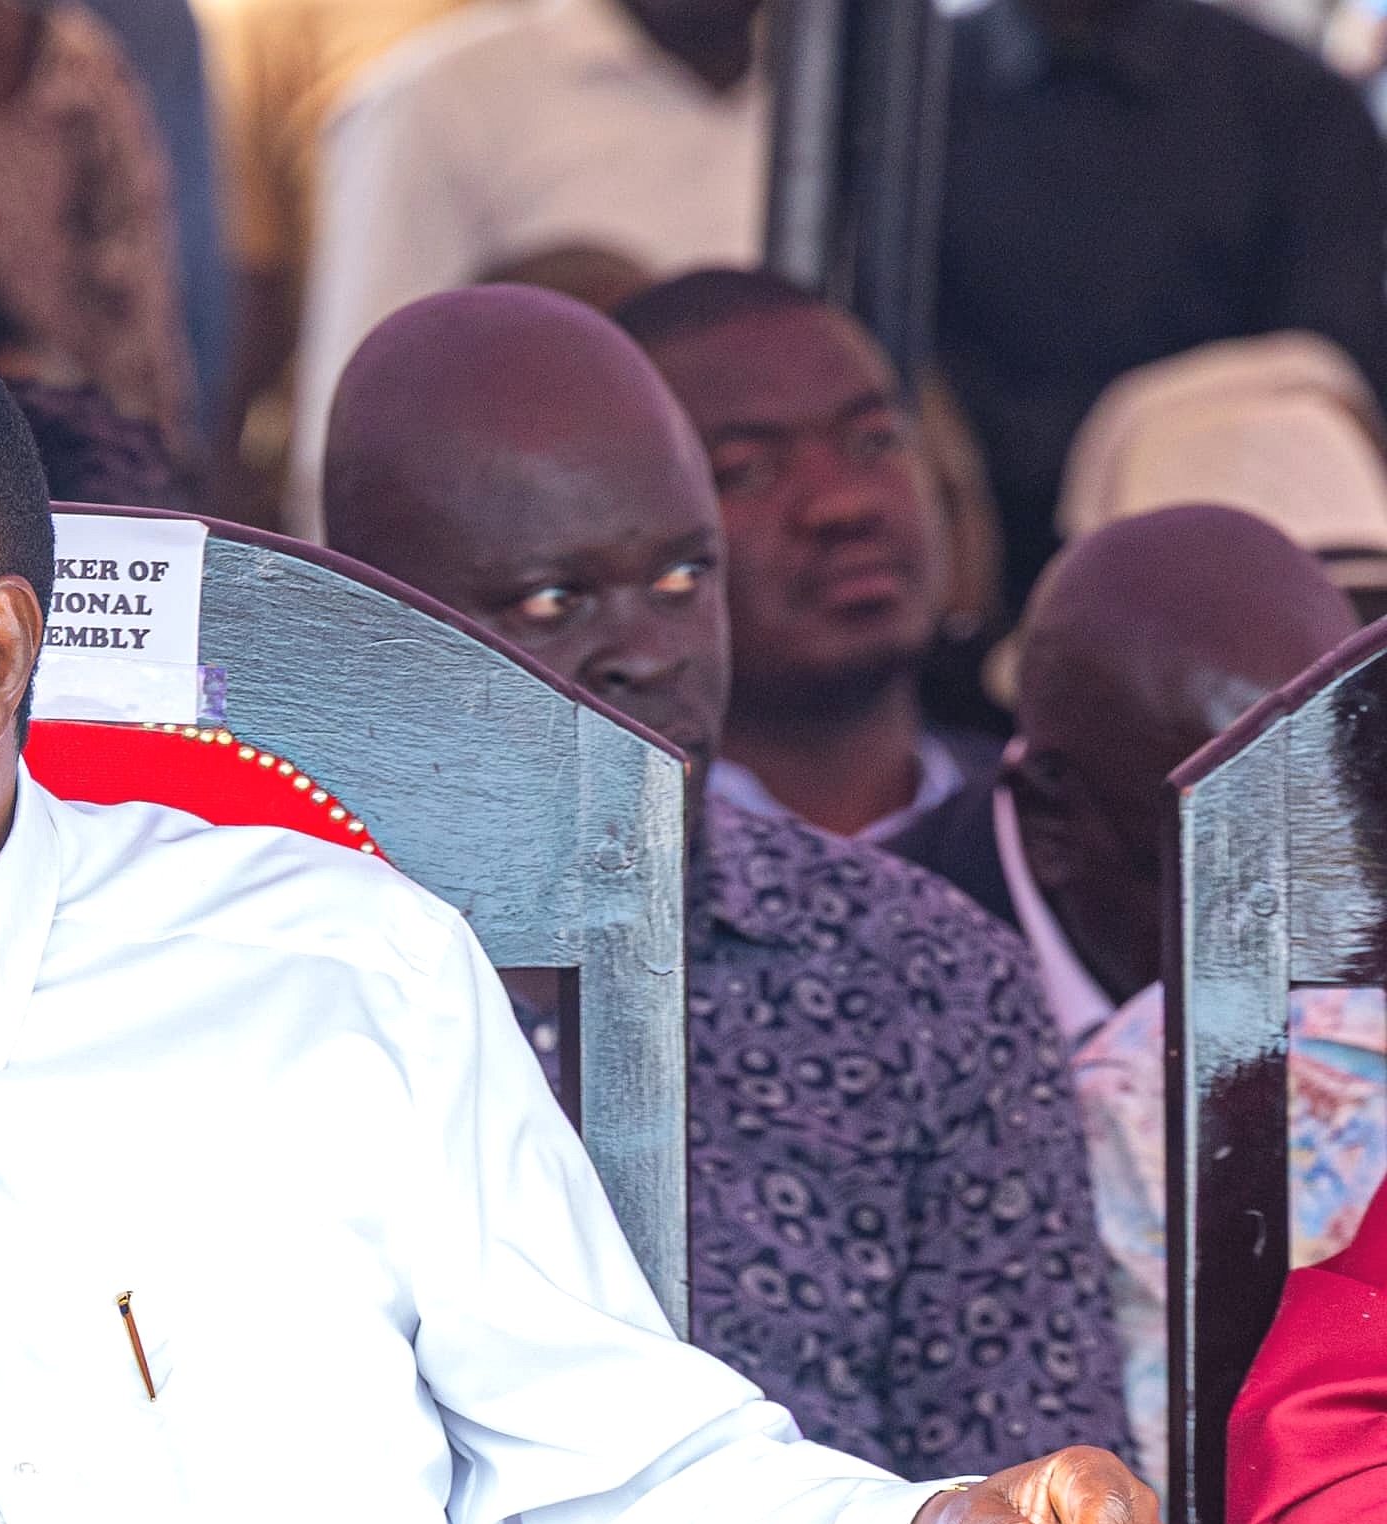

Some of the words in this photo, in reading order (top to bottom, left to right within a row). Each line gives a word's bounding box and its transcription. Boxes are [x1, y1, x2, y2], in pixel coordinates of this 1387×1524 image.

[128, 560, 170, 582] OF
[52, 592, 153, 616] IONAL
[44, 626, 151, 649] EMBLY
